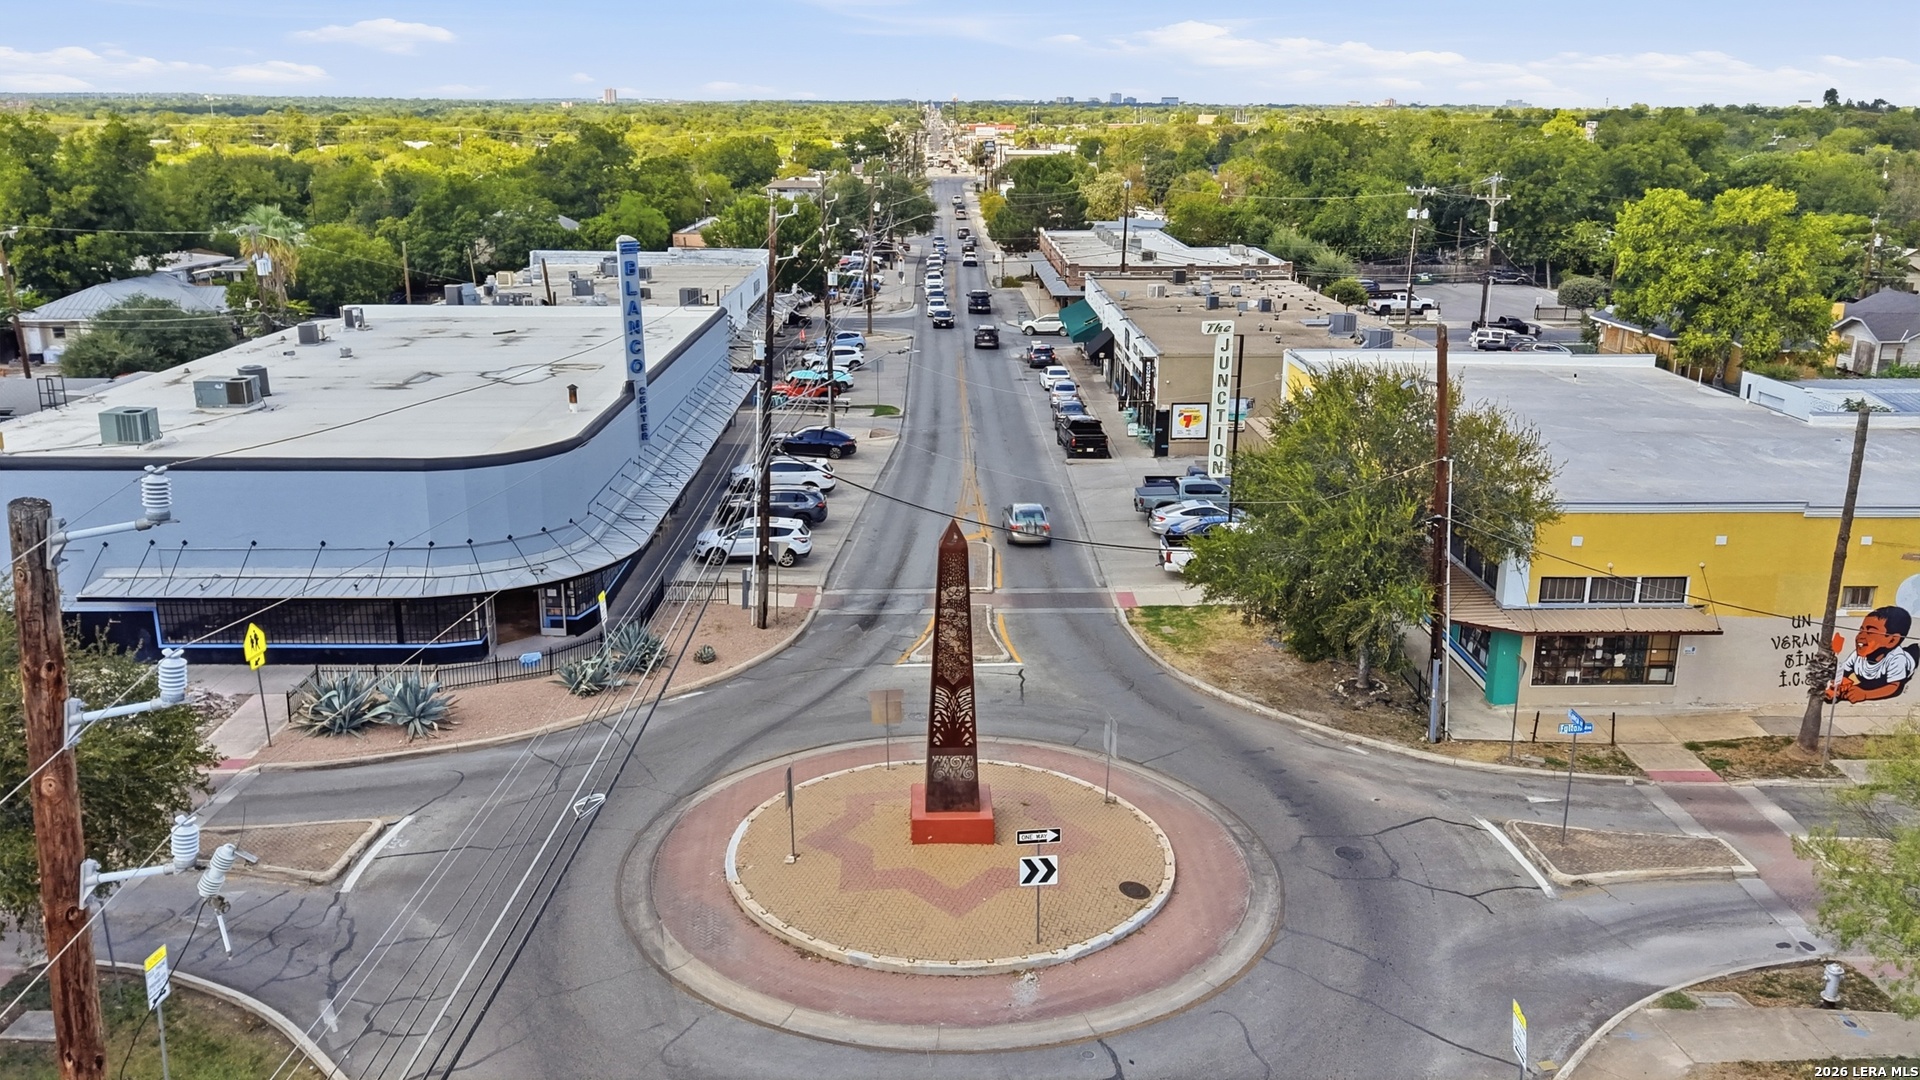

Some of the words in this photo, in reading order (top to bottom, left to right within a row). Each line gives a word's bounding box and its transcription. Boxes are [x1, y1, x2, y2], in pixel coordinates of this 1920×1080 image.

[624, 260, 644, 374] BLANCO
[1206, 322, 1231, 334] The
[638, 386, 648, 440] CENTER
[1212, 338, 1230, 474] JUNCTION
[1791, 613, 1811, 629] UN
[1771, 632, 1819, 650] VERAN
[1784, 650, 1814, 668] SIN
